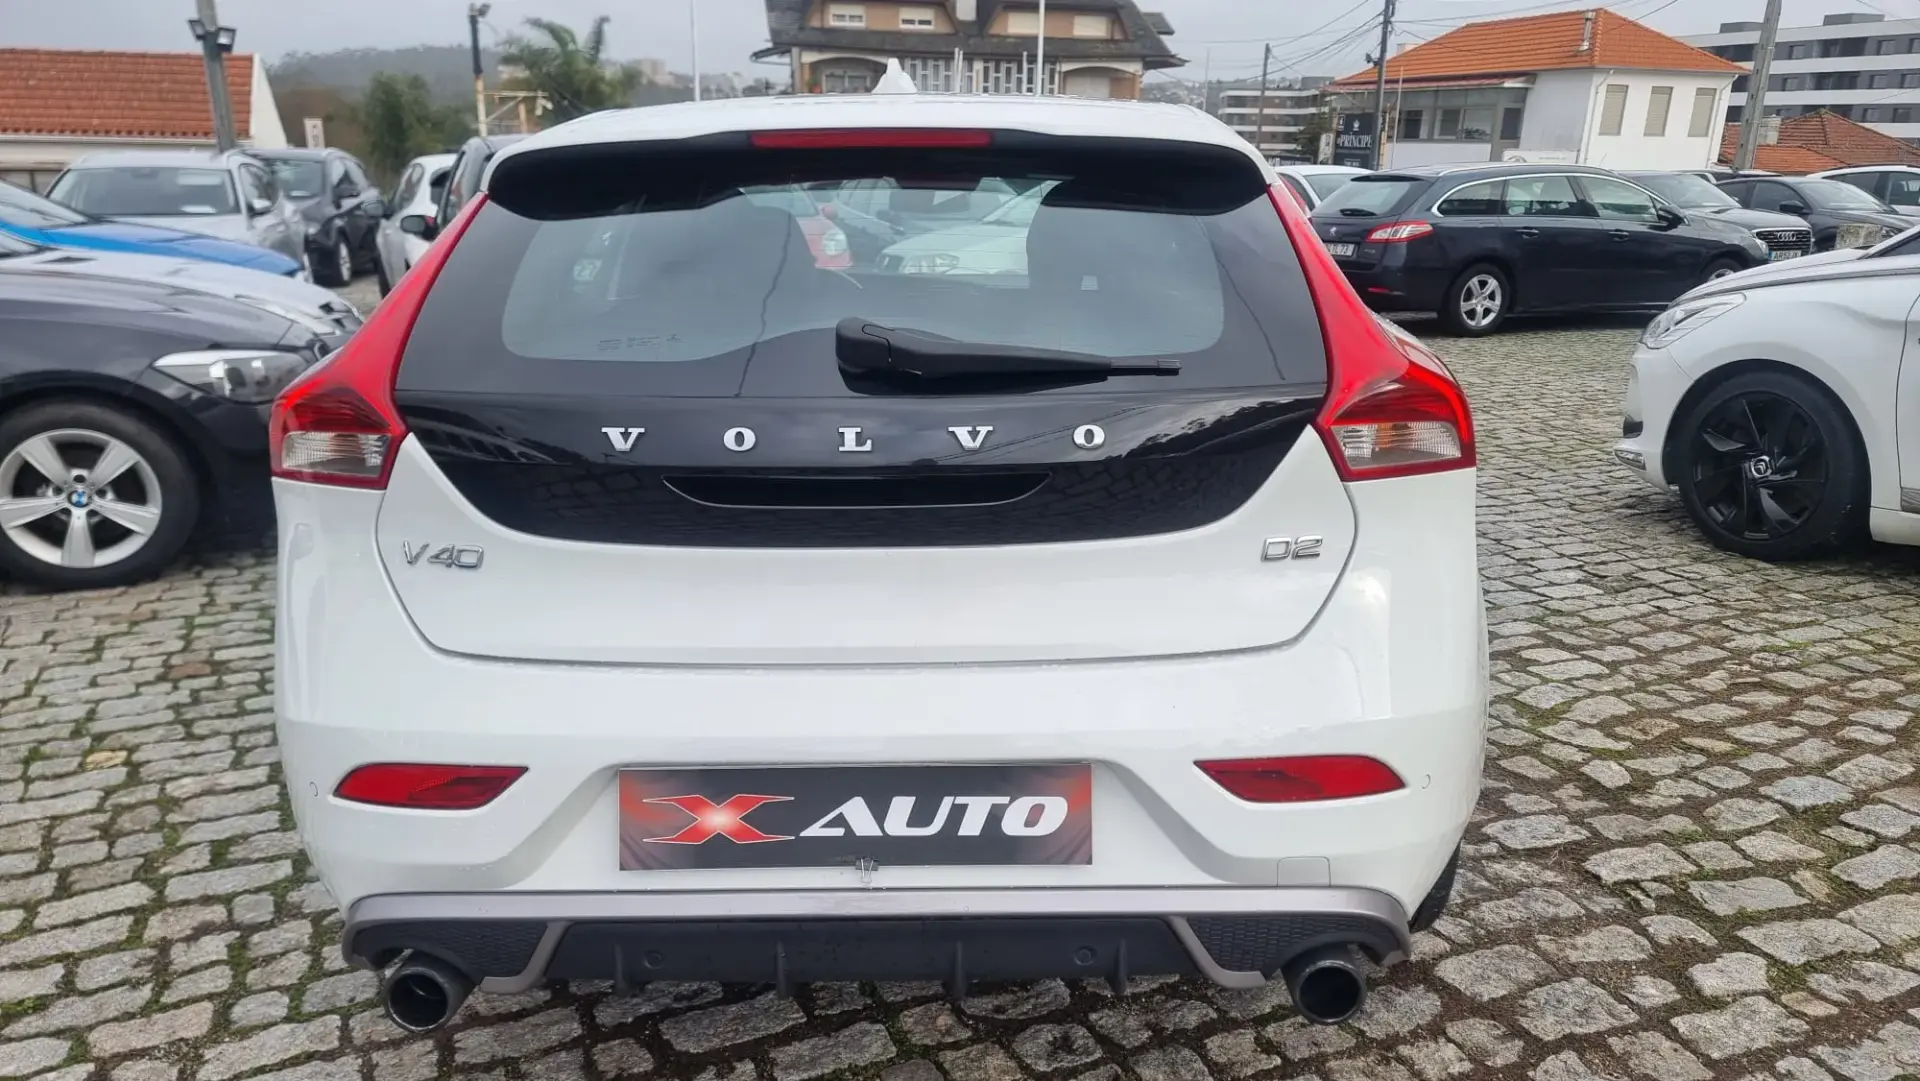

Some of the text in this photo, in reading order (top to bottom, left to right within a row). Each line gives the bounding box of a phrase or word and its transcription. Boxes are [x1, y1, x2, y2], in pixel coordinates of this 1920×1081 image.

[601, 424, 1106, 453] VOLVO
[403, 540, 484, 570] V40
[1260, 535, 1323, 562] D2
[643, 794, 1069, 845] X AUTO
